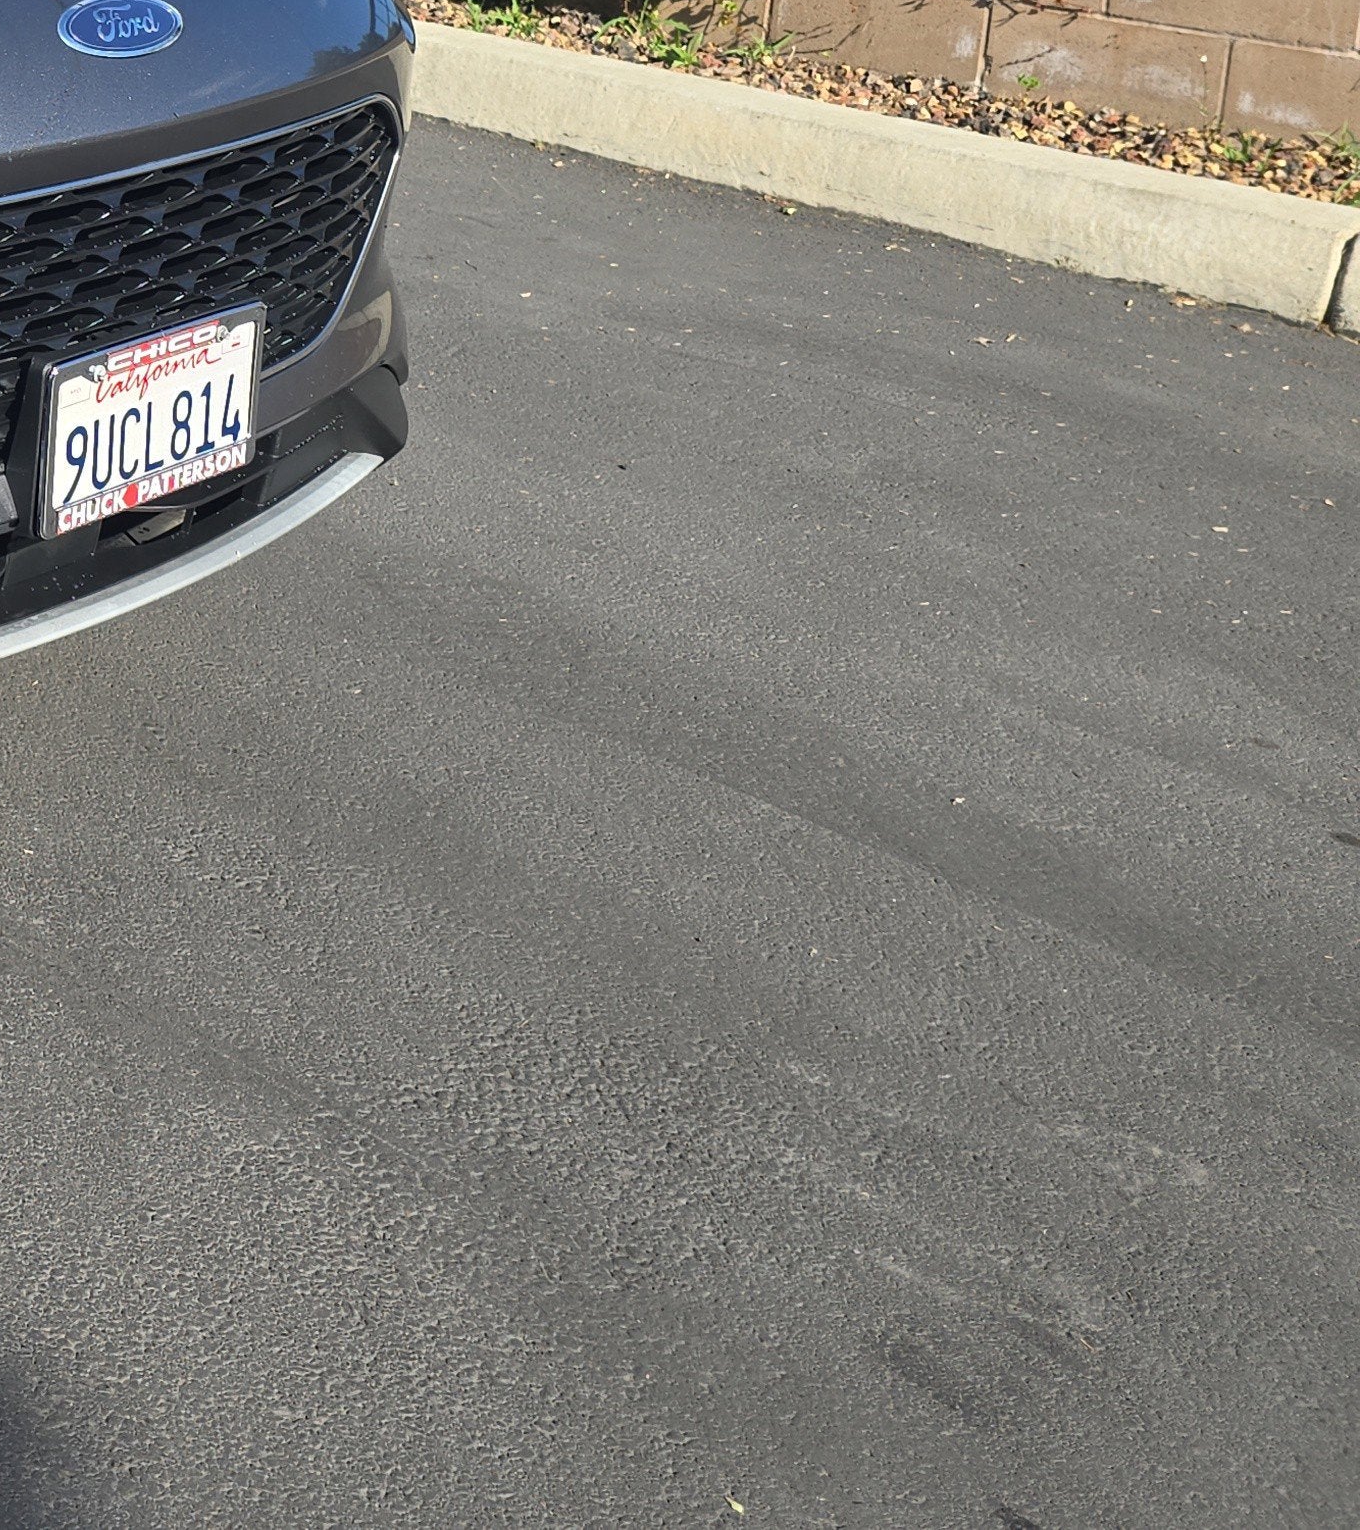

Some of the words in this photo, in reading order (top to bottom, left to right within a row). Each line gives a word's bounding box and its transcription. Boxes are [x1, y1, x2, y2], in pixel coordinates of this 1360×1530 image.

[93, 4, 160, 42] Ford
[96, 347, 222, 403] California
[107, 324, 218, 373] CHICO
[63, 373, 241, 505] 9UCL814
[58, 489, 129, 533] CHUCK
[137, 443, 247, 503] PATTERSON
